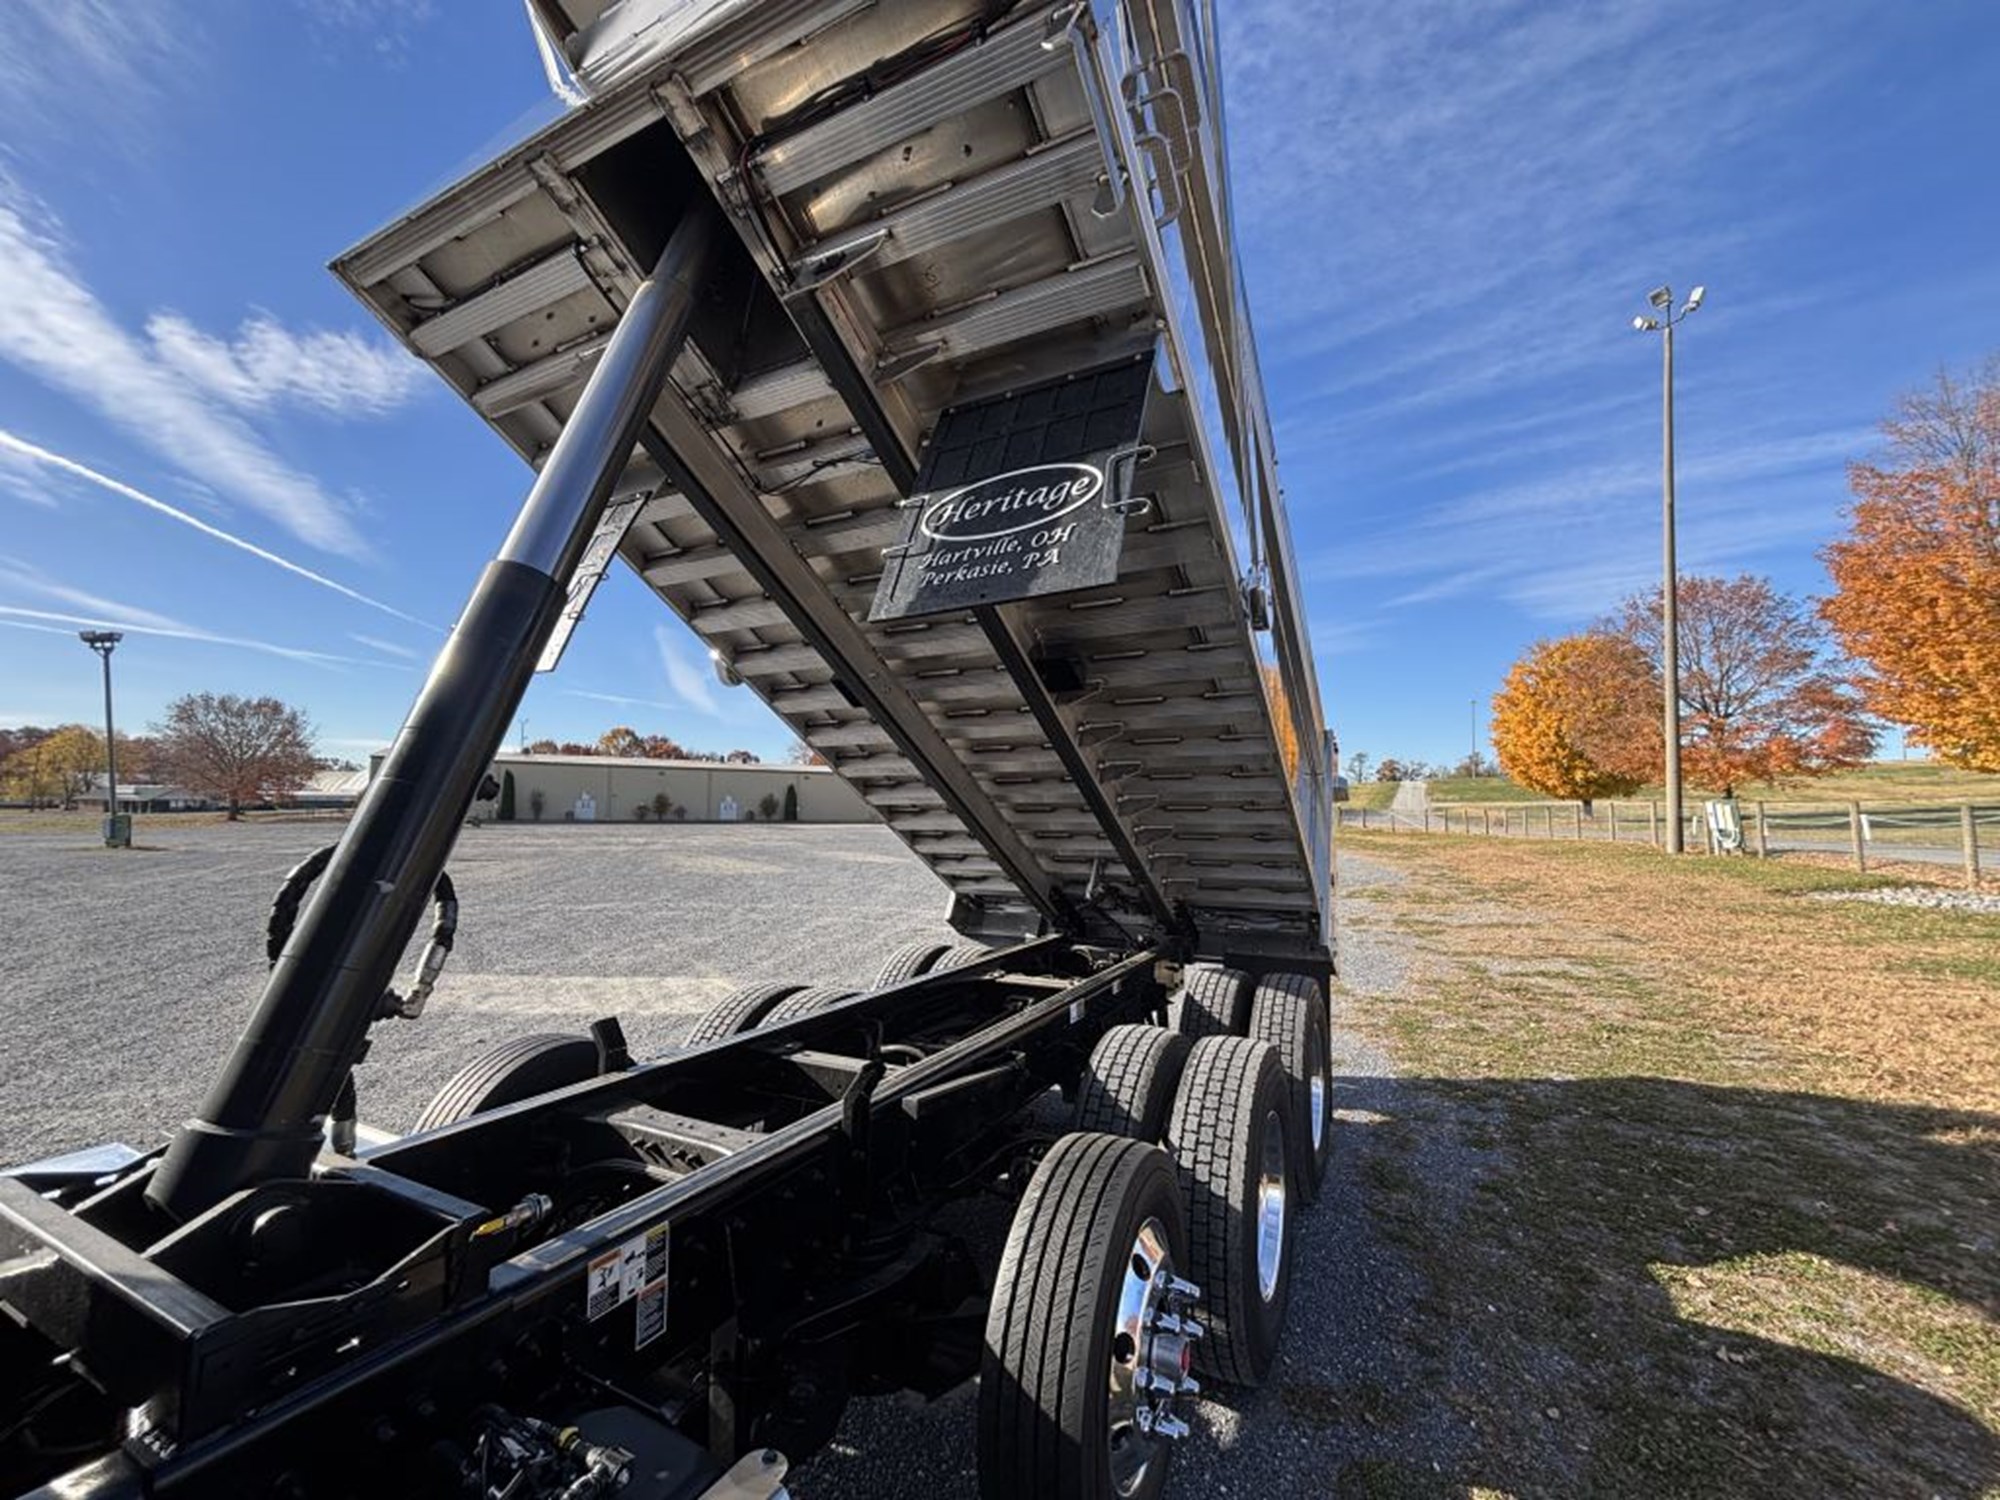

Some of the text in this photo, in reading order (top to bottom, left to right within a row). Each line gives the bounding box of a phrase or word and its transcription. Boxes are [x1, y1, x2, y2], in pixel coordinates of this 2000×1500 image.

[928, 476, 1091, 527] Heritage
[1031, 523, 1077, 548] OH
[1022, 548, 1061, 569] PA
